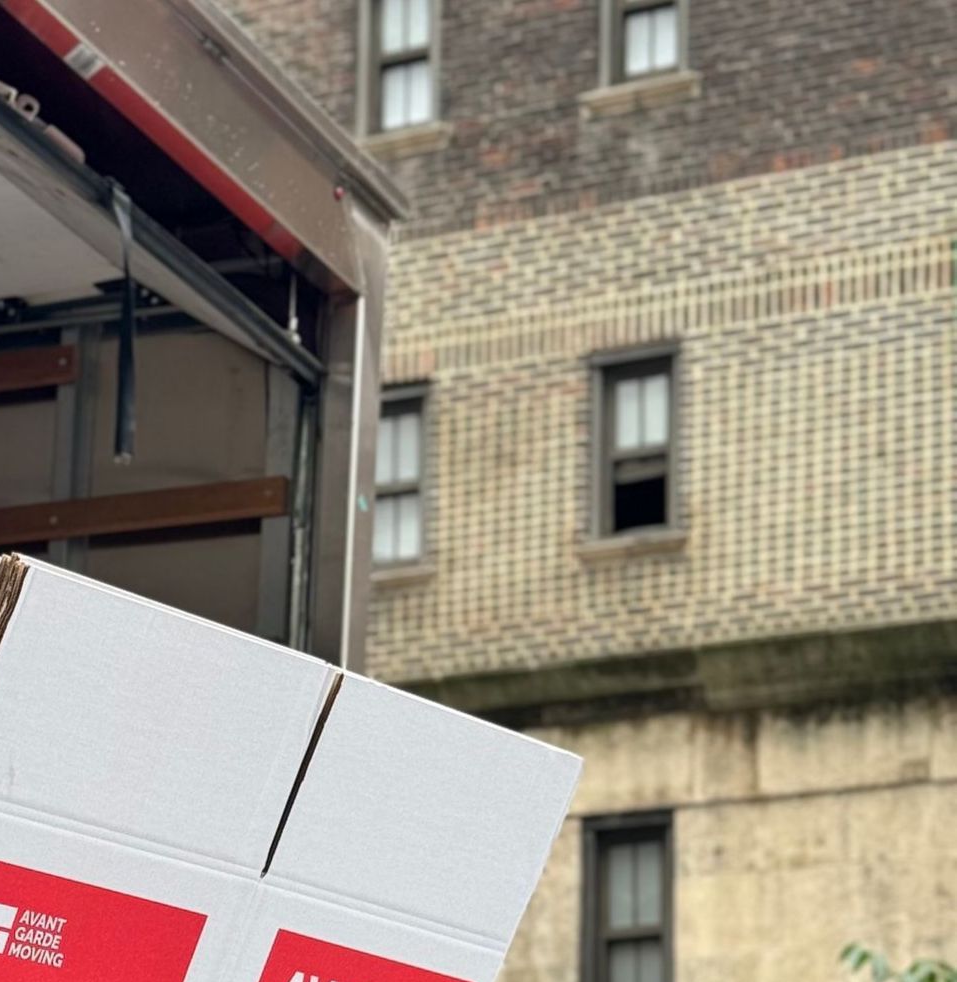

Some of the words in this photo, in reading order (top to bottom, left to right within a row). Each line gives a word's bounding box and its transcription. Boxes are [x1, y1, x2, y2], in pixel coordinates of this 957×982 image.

[19, 910, 67, 933] AVANT
[15, 927, 62, 949] GARDE
[8, 942, 64, 968] MOVING
